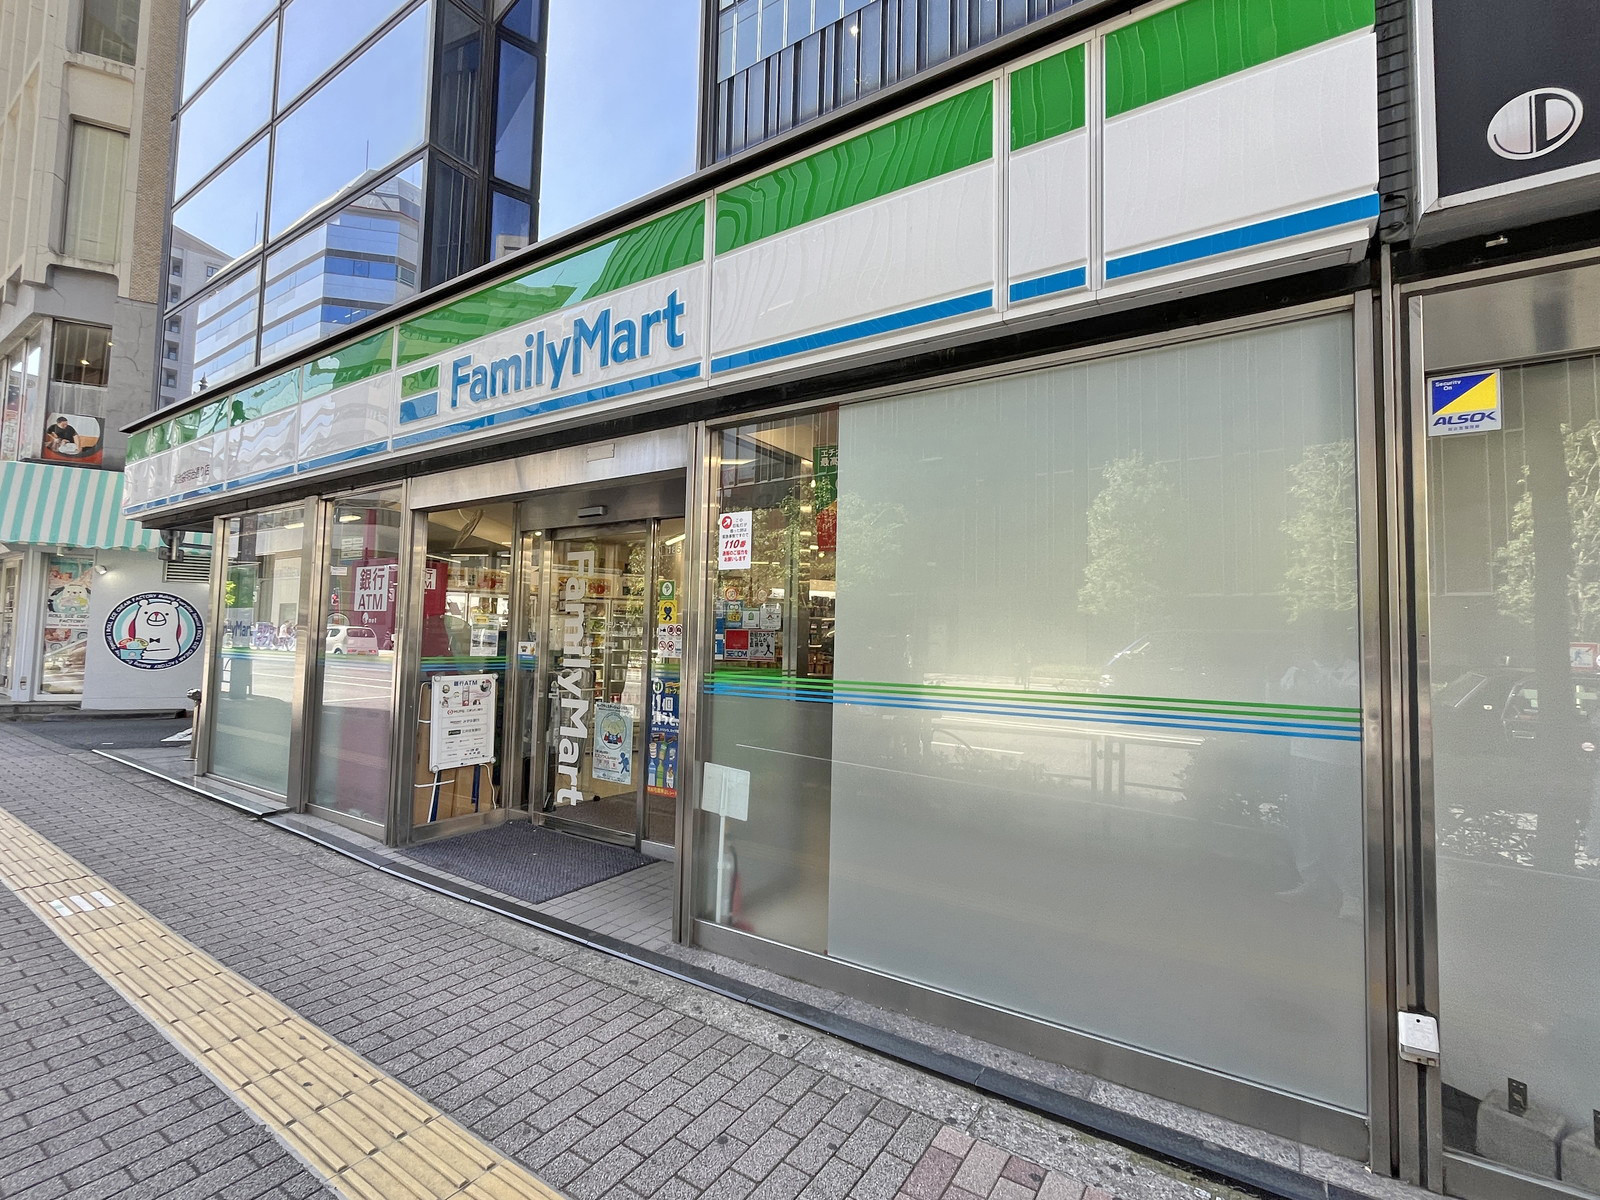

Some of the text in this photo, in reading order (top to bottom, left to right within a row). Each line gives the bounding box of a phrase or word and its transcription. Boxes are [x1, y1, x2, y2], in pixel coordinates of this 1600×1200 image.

[451, 289, 686, 409] FamilyMart
[1433, 411, 1497, 426] ALSOK
[359, 568, 385, 591] 銀行
[132, 594, 157, 602] FACTORY
[357, 593, 383, 610] ATM
[557, 550, 594, 806] FamilyMart
